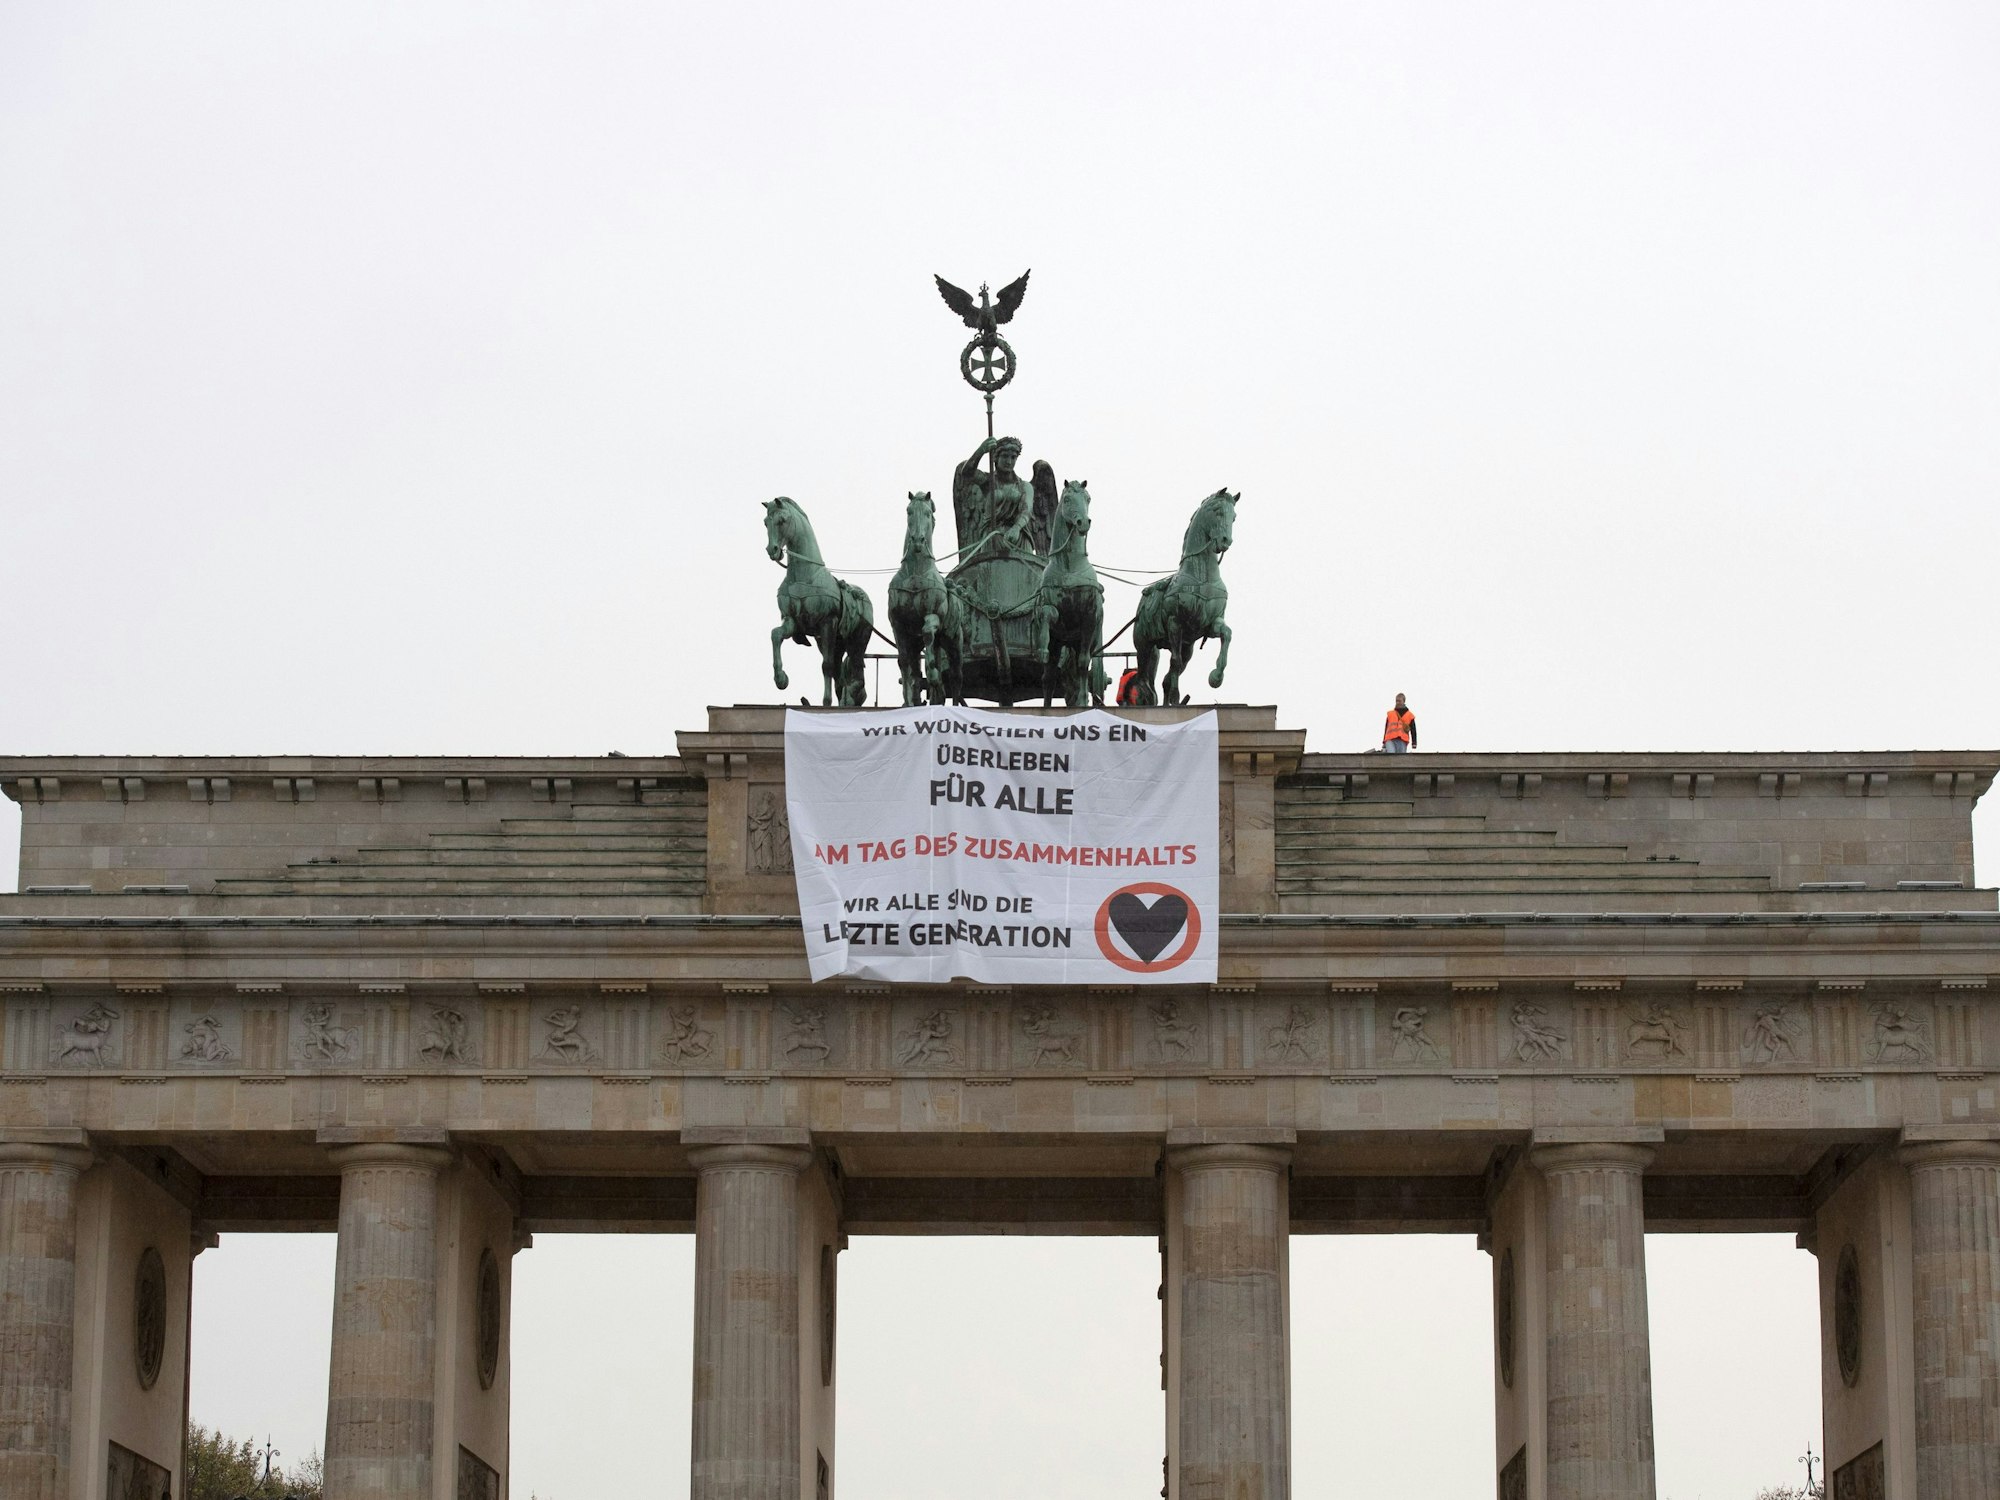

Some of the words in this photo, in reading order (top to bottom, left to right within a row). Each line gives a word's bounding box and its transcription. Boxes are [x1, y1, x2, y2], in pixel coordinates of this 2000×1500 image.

[861, 724, 907, 737] WIR
[914, 718, 1045, 739] WÜNSCHEN
[1054, 724, 1100, 741] UNS
[1109, 724, 1147, 742] EIN
[937, 743, 1070, 773] ÜBERLEBEN
[930, 772, 986, 807] FÜR
[994, 784, 1074, 815] ALLE
[815, 843, 849, 865] AM
[857, 839, 906, 863] TAG
[915, 831, 958, 857] DES
[964, 836, 1197, 867] ZUSAMMENHALTS
[844, 897, 880, 913] WIR
[886, 893, 939, 911] ALLE
[947, 888, 988, 912] SIND
[996, 896, 1033, 913] DIE
[909, 918, 1071, 948] GENERATION
